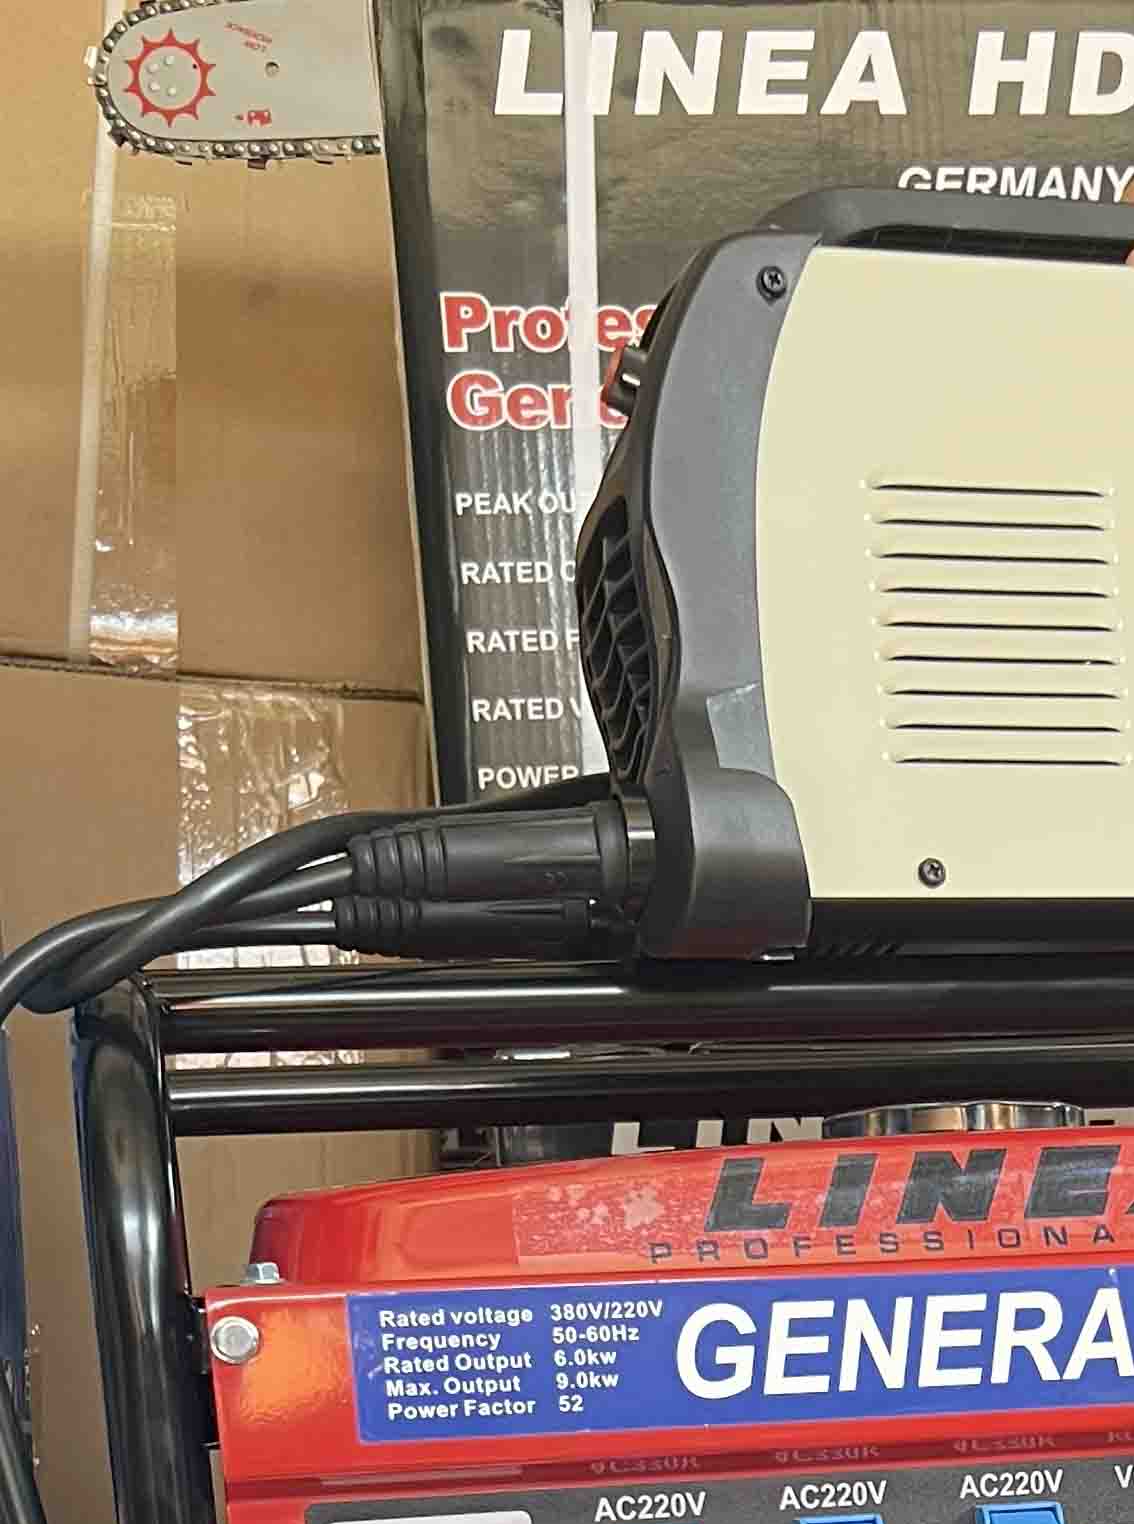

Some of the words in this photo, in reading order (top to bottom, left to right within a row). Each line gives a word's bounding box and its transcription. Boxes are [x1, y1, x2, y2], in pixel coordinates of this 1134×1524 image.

[495, 29, 907, 117] LINEA
[439, 291, 657, 353] Proe
[456, 493, 531, 515] PEAK
[461, 562, 551, 585] RATED
[466, 630, 557, 653] RATED
[472, 699, 563, 722] RATED
[379, 1309, 444, 1330] Rated
[450, 1305, 534, 1329] voltage
[550, 1300, 665, 1323] 380V/220V
[381, 1329, 502, 1353] Frequency
[551, 1323, 640, 1345] 50-60Hz
[383, 1354, 449, 1375] Rated
[454, 1350, 533, 1375] Output
[553, 1347, 617, 1367] 6.0kw
[386, 1377, 439, 1398] Max.
[443, 1374, 522, 1398] Output
[555, 1371, 619, 1390] 9.0kw
[387, 1401, 459, 1421] Power
[463, 1396, 537, 1418] Factor
[557, 1394, 585, 1414] 52
[778, 1479, 888, 1512] AC220V
[959, 1469, 1064, 1500] AC220V
[594, 1491, 707, 1523] AC220V
